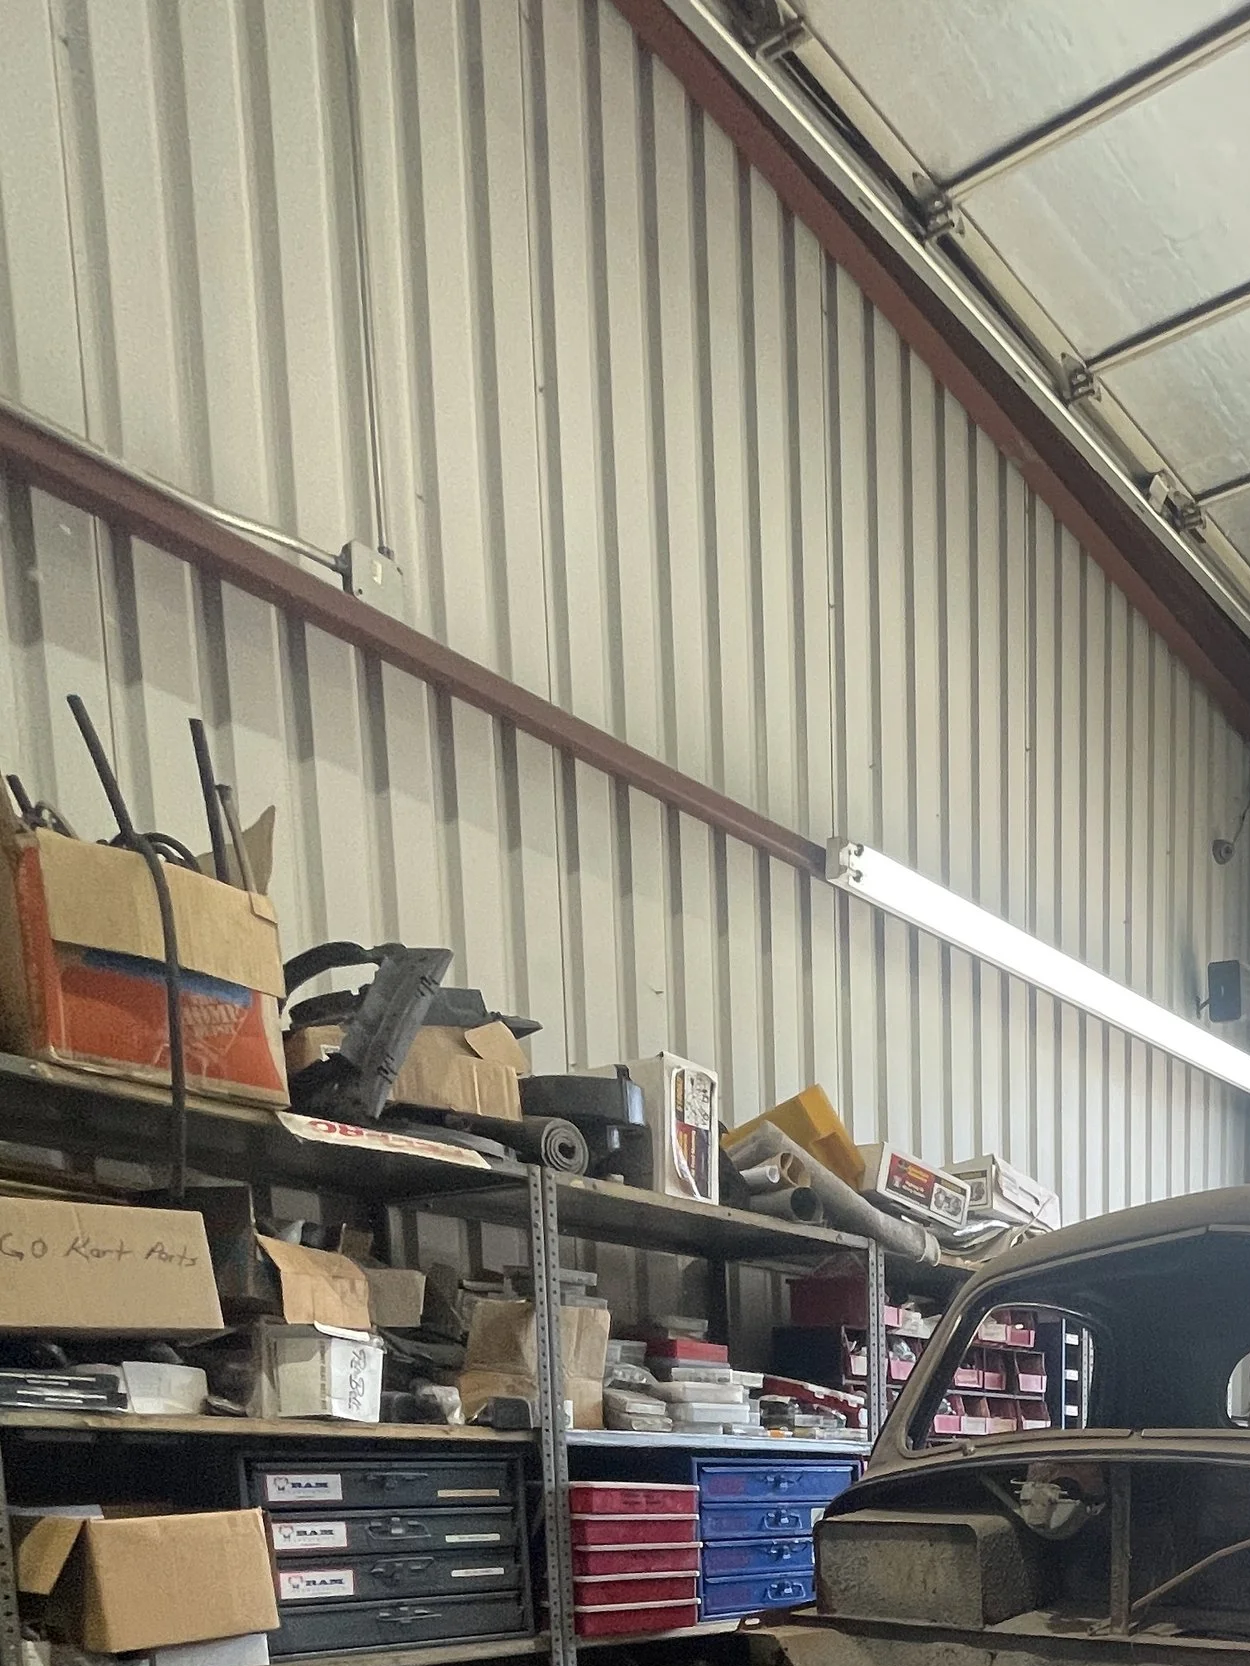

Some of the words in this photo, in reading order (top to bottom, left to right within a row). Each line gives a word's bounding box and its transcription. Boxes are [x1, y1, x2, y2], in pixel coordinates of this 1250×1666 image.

[63, 1236, 133, 1262] Kart
[145, 1241, 198, 1267] Parts
[305, 1578, 345, 1587] RAM
